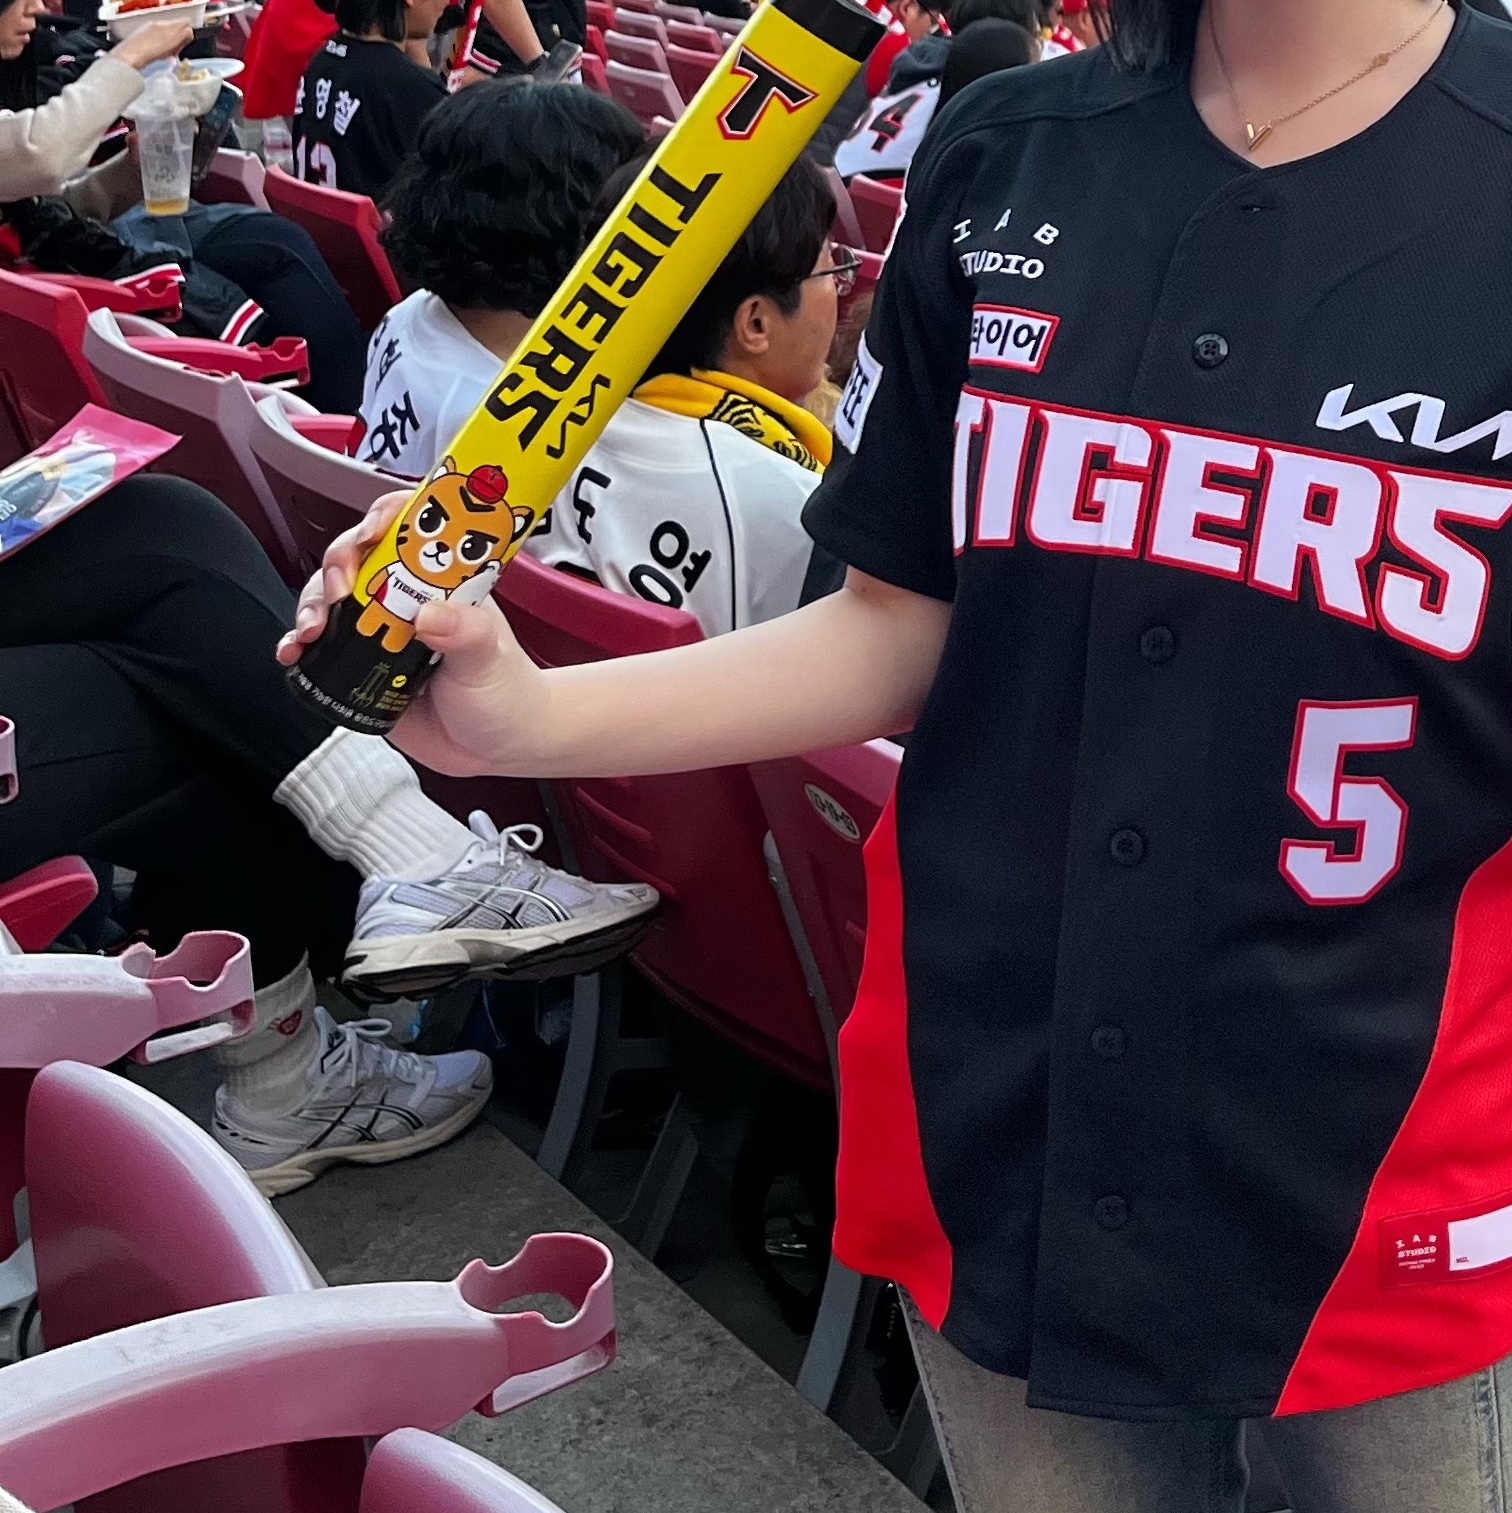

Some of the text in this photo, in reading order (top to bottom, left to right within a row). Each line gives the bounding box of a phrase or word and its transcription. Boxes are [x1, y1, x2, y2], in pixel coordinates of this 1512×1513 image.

[716, 43, 820, 141] T
[485, 164, 724, 452] TIGERS
[1278, 695, 1420, 907] 5
[1397, 1245, 1438, 1259] STUDIO
